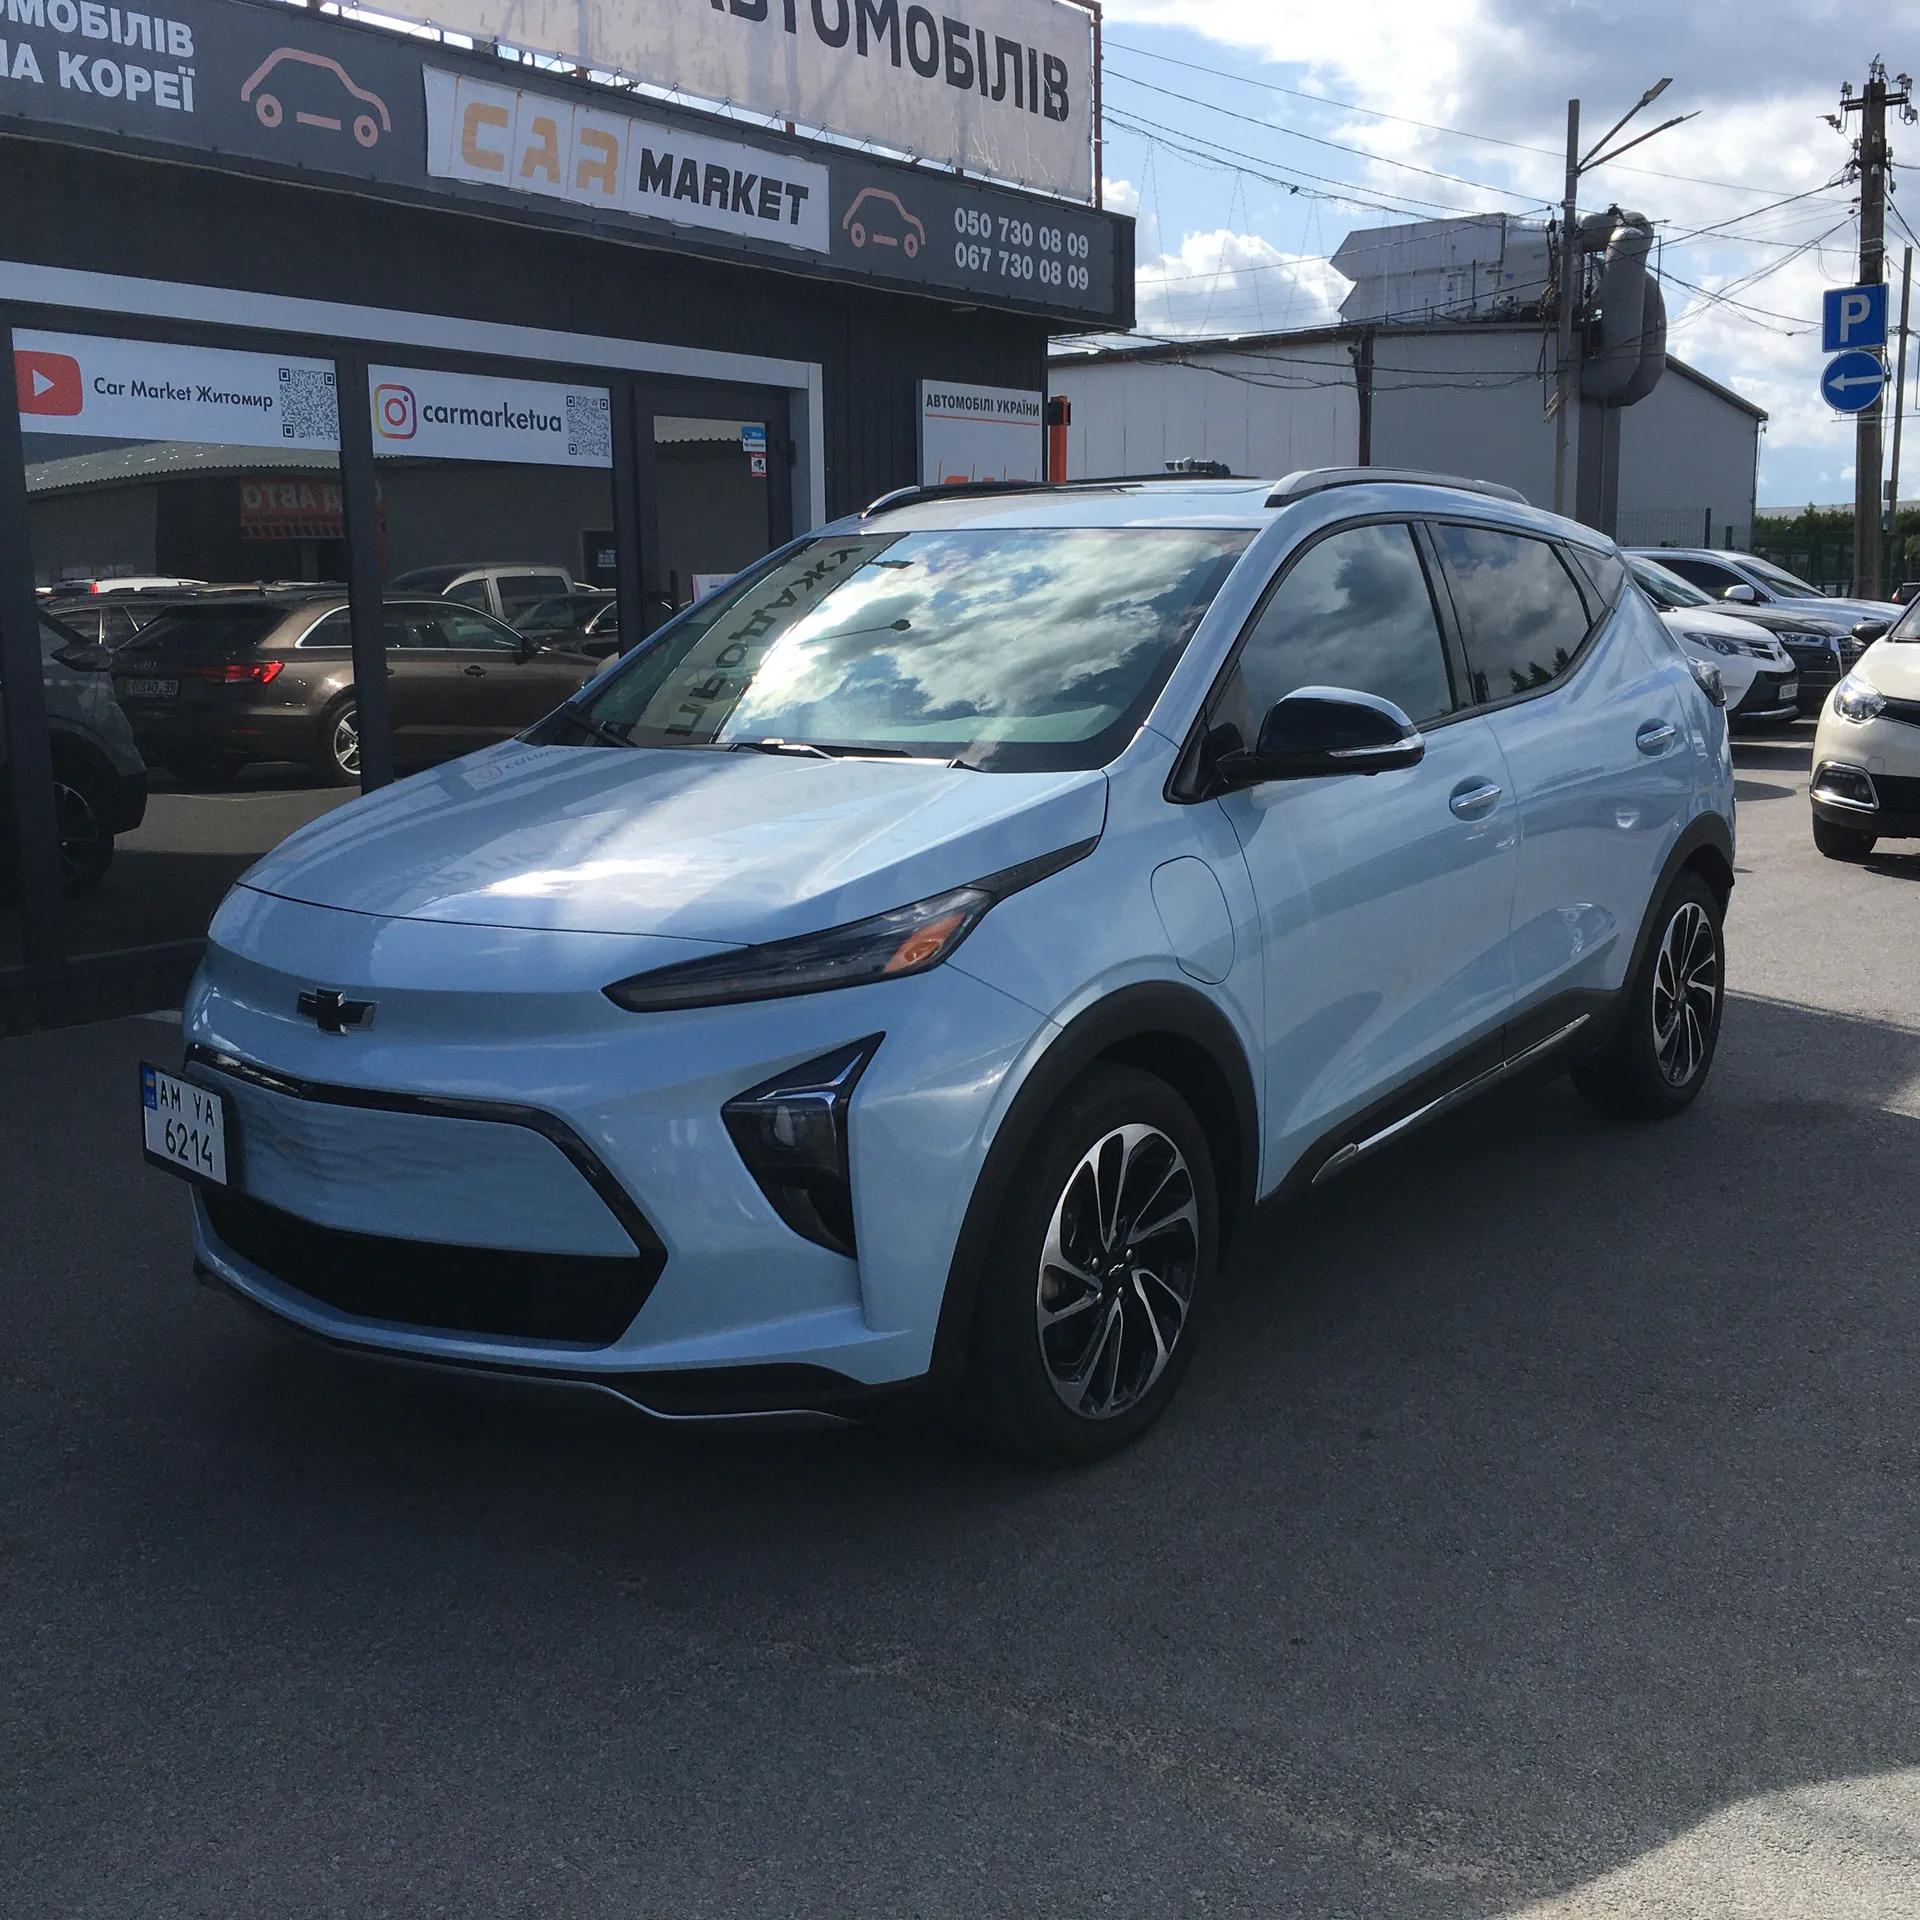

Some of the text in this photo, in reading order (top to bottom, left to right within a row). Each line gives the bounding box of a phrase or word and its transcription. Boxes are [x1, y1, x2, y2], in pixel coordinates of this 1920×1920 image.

[0, 0, 195, 58] МОБІЛІВ
[58, 51, 196, 113] КОРЕЇ
[704, 0, 1070, 122] ОМОБІЛІВ
[461, 102, 810, 226] CAR MARKET
[954, 207, 1089, 259] 050 730 08 09
[954, 241, 1089, 291] 067 730 08 09
[1840, 293, 1871, 343] P
[93, 376, 274, 412] Car Market Житомир
[422, 402, 563, 433] carmarketua
[925, 393, 1040, 417] АВТОМОБІЛІ УКРАЇНИ
[193, 1092, 215, 1128] YA
[165, 1117, 215, 1173] 6214
